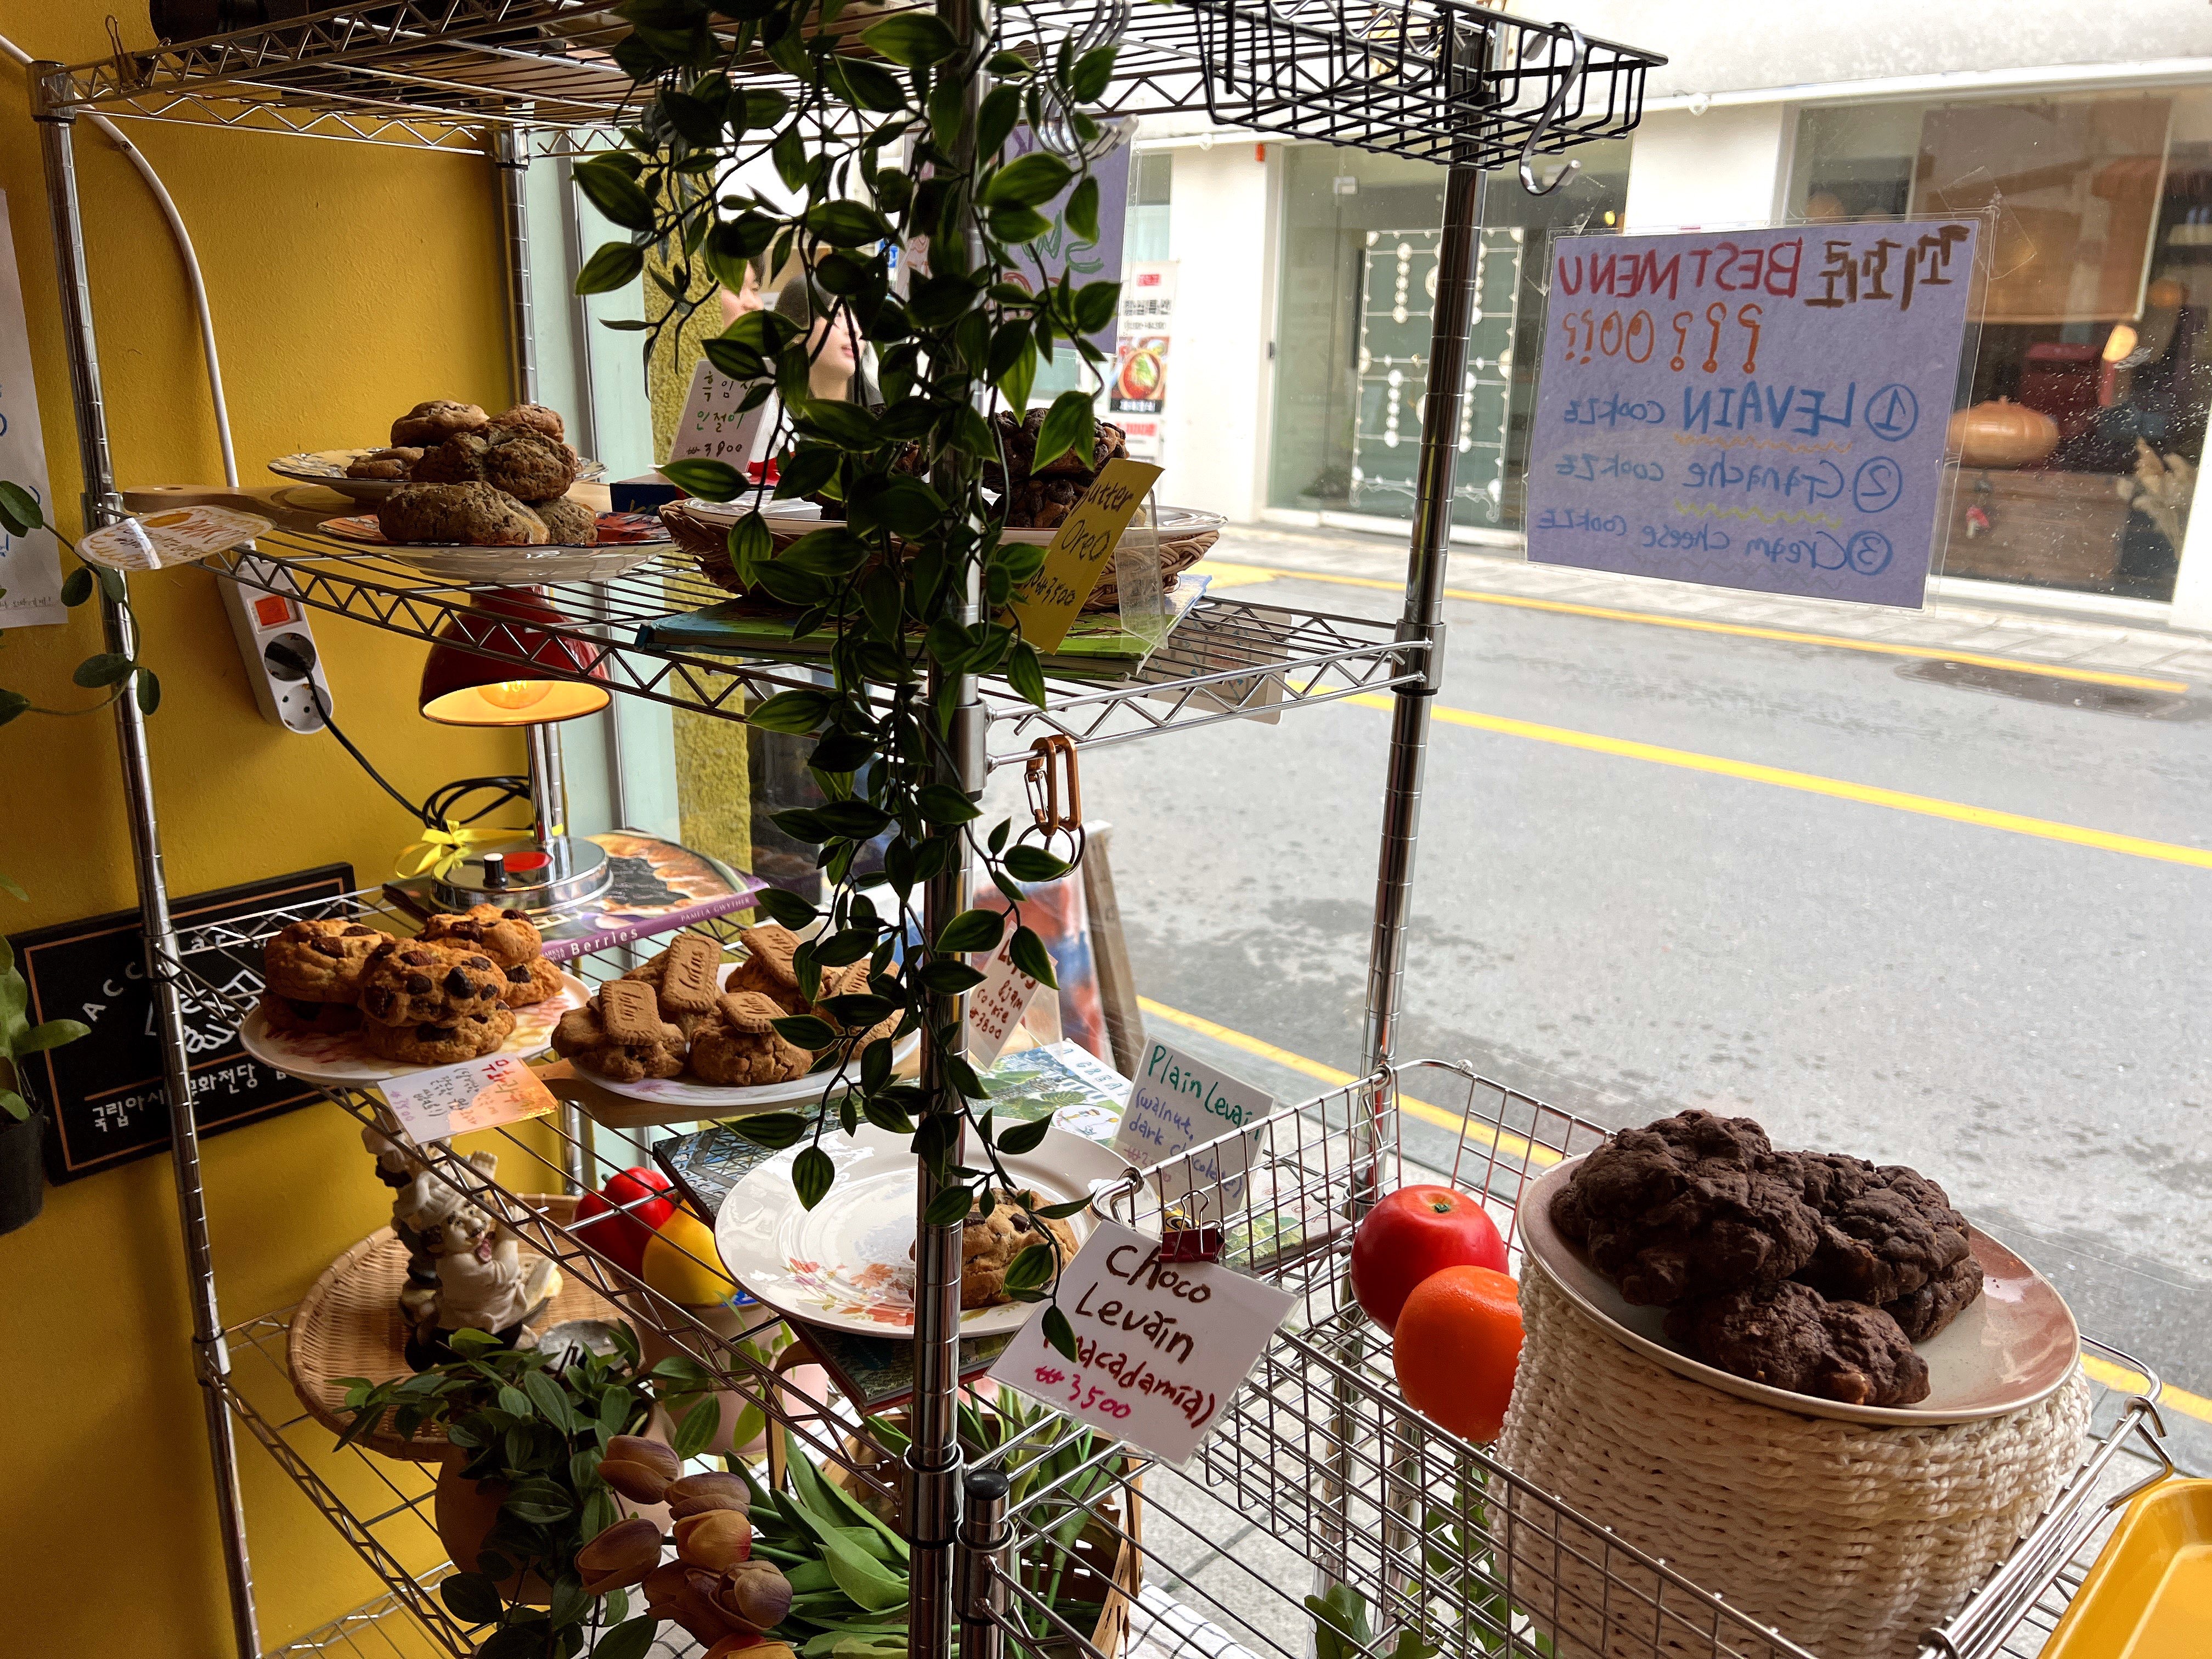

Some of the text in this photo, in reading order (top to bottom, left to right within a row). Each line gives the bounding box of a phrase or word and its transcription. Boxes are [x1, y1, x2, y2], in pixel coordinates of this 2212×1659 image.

[1070, 482, 1135, 517] utter
[570, 929, 638, 956] Berries
[1148, 1045, 1203, 1099] Plain
[1128, 1113, 1165, 1146] dark
[1106, 1244, 1211, 1304] Choco
[1075, 1281, 1194, 1365] Levain
